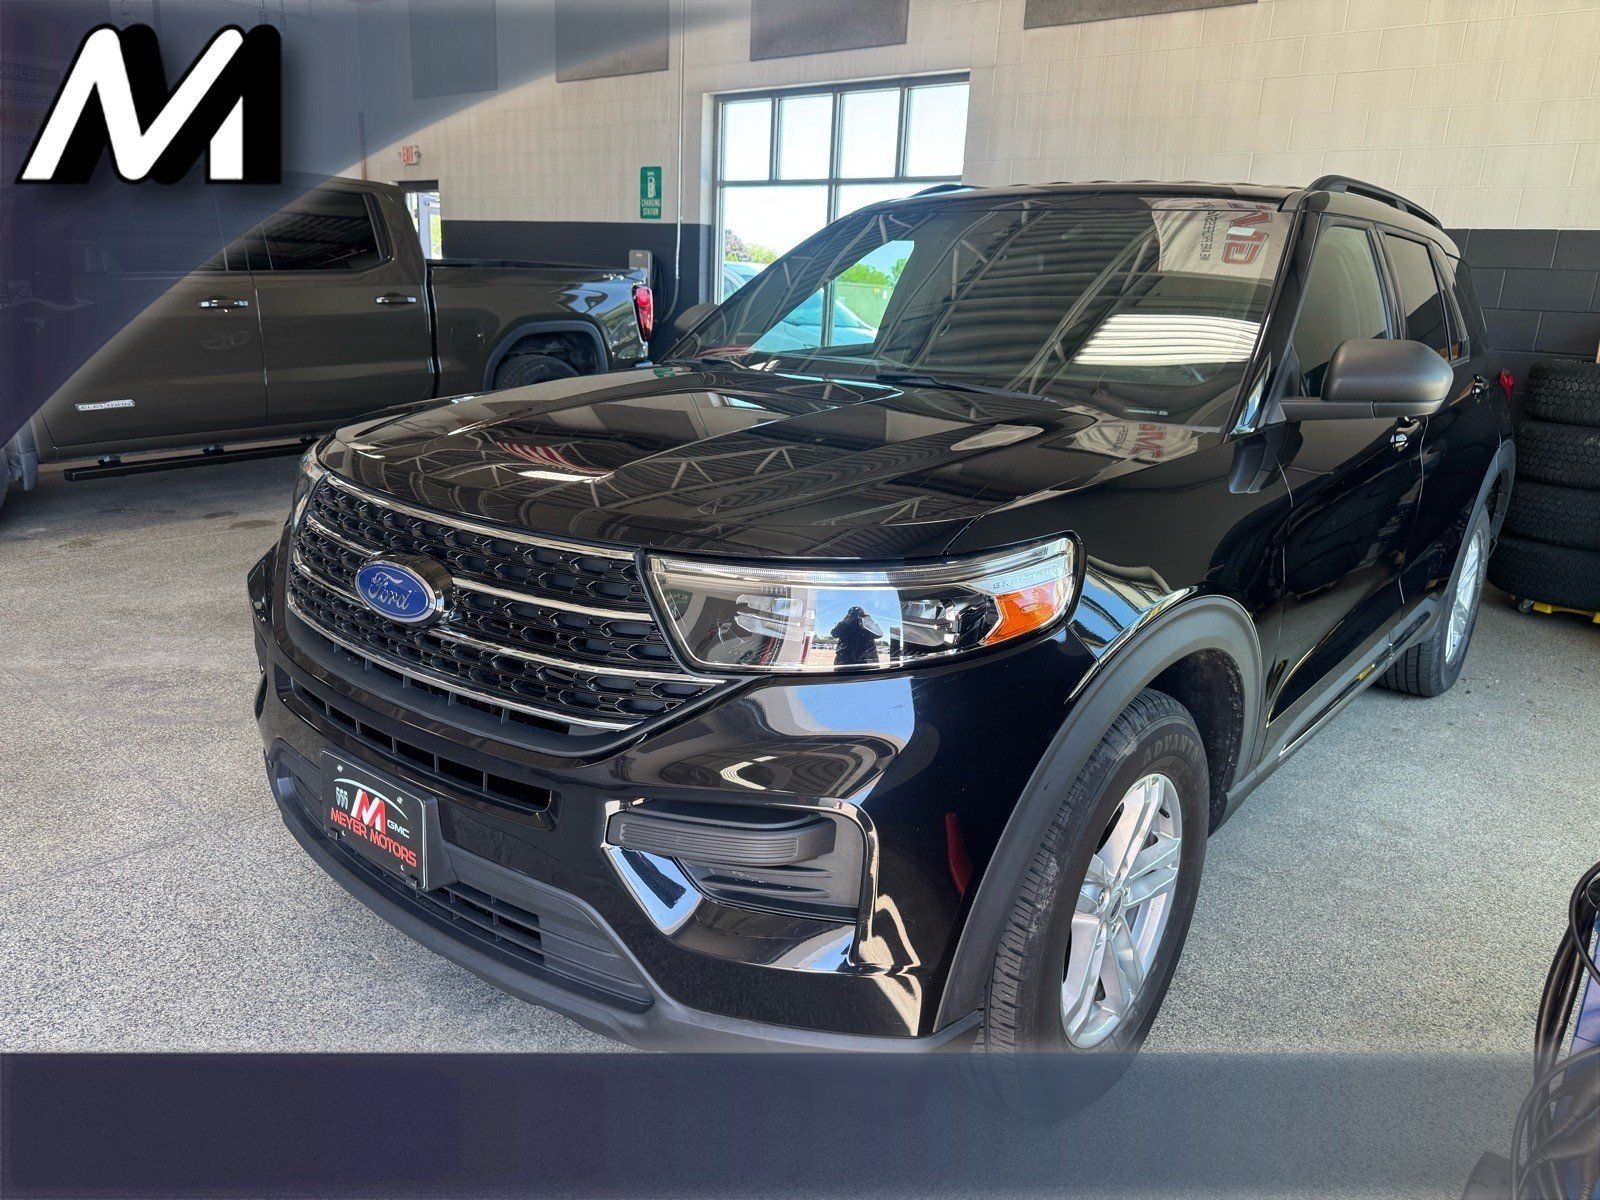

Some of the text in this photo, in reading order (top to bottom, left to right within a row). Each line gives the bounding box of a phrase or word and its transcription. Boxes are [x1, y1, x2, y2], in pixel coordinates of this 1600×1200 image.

[641, 199, 661, 207] CHARGING
[78, 400, 134, 411] ELEVATION
[368, 571, 412, 610] Ford
[330, 806, 417, 868] MEYER MOTORS
[387, 819, 410, 839] GMC
